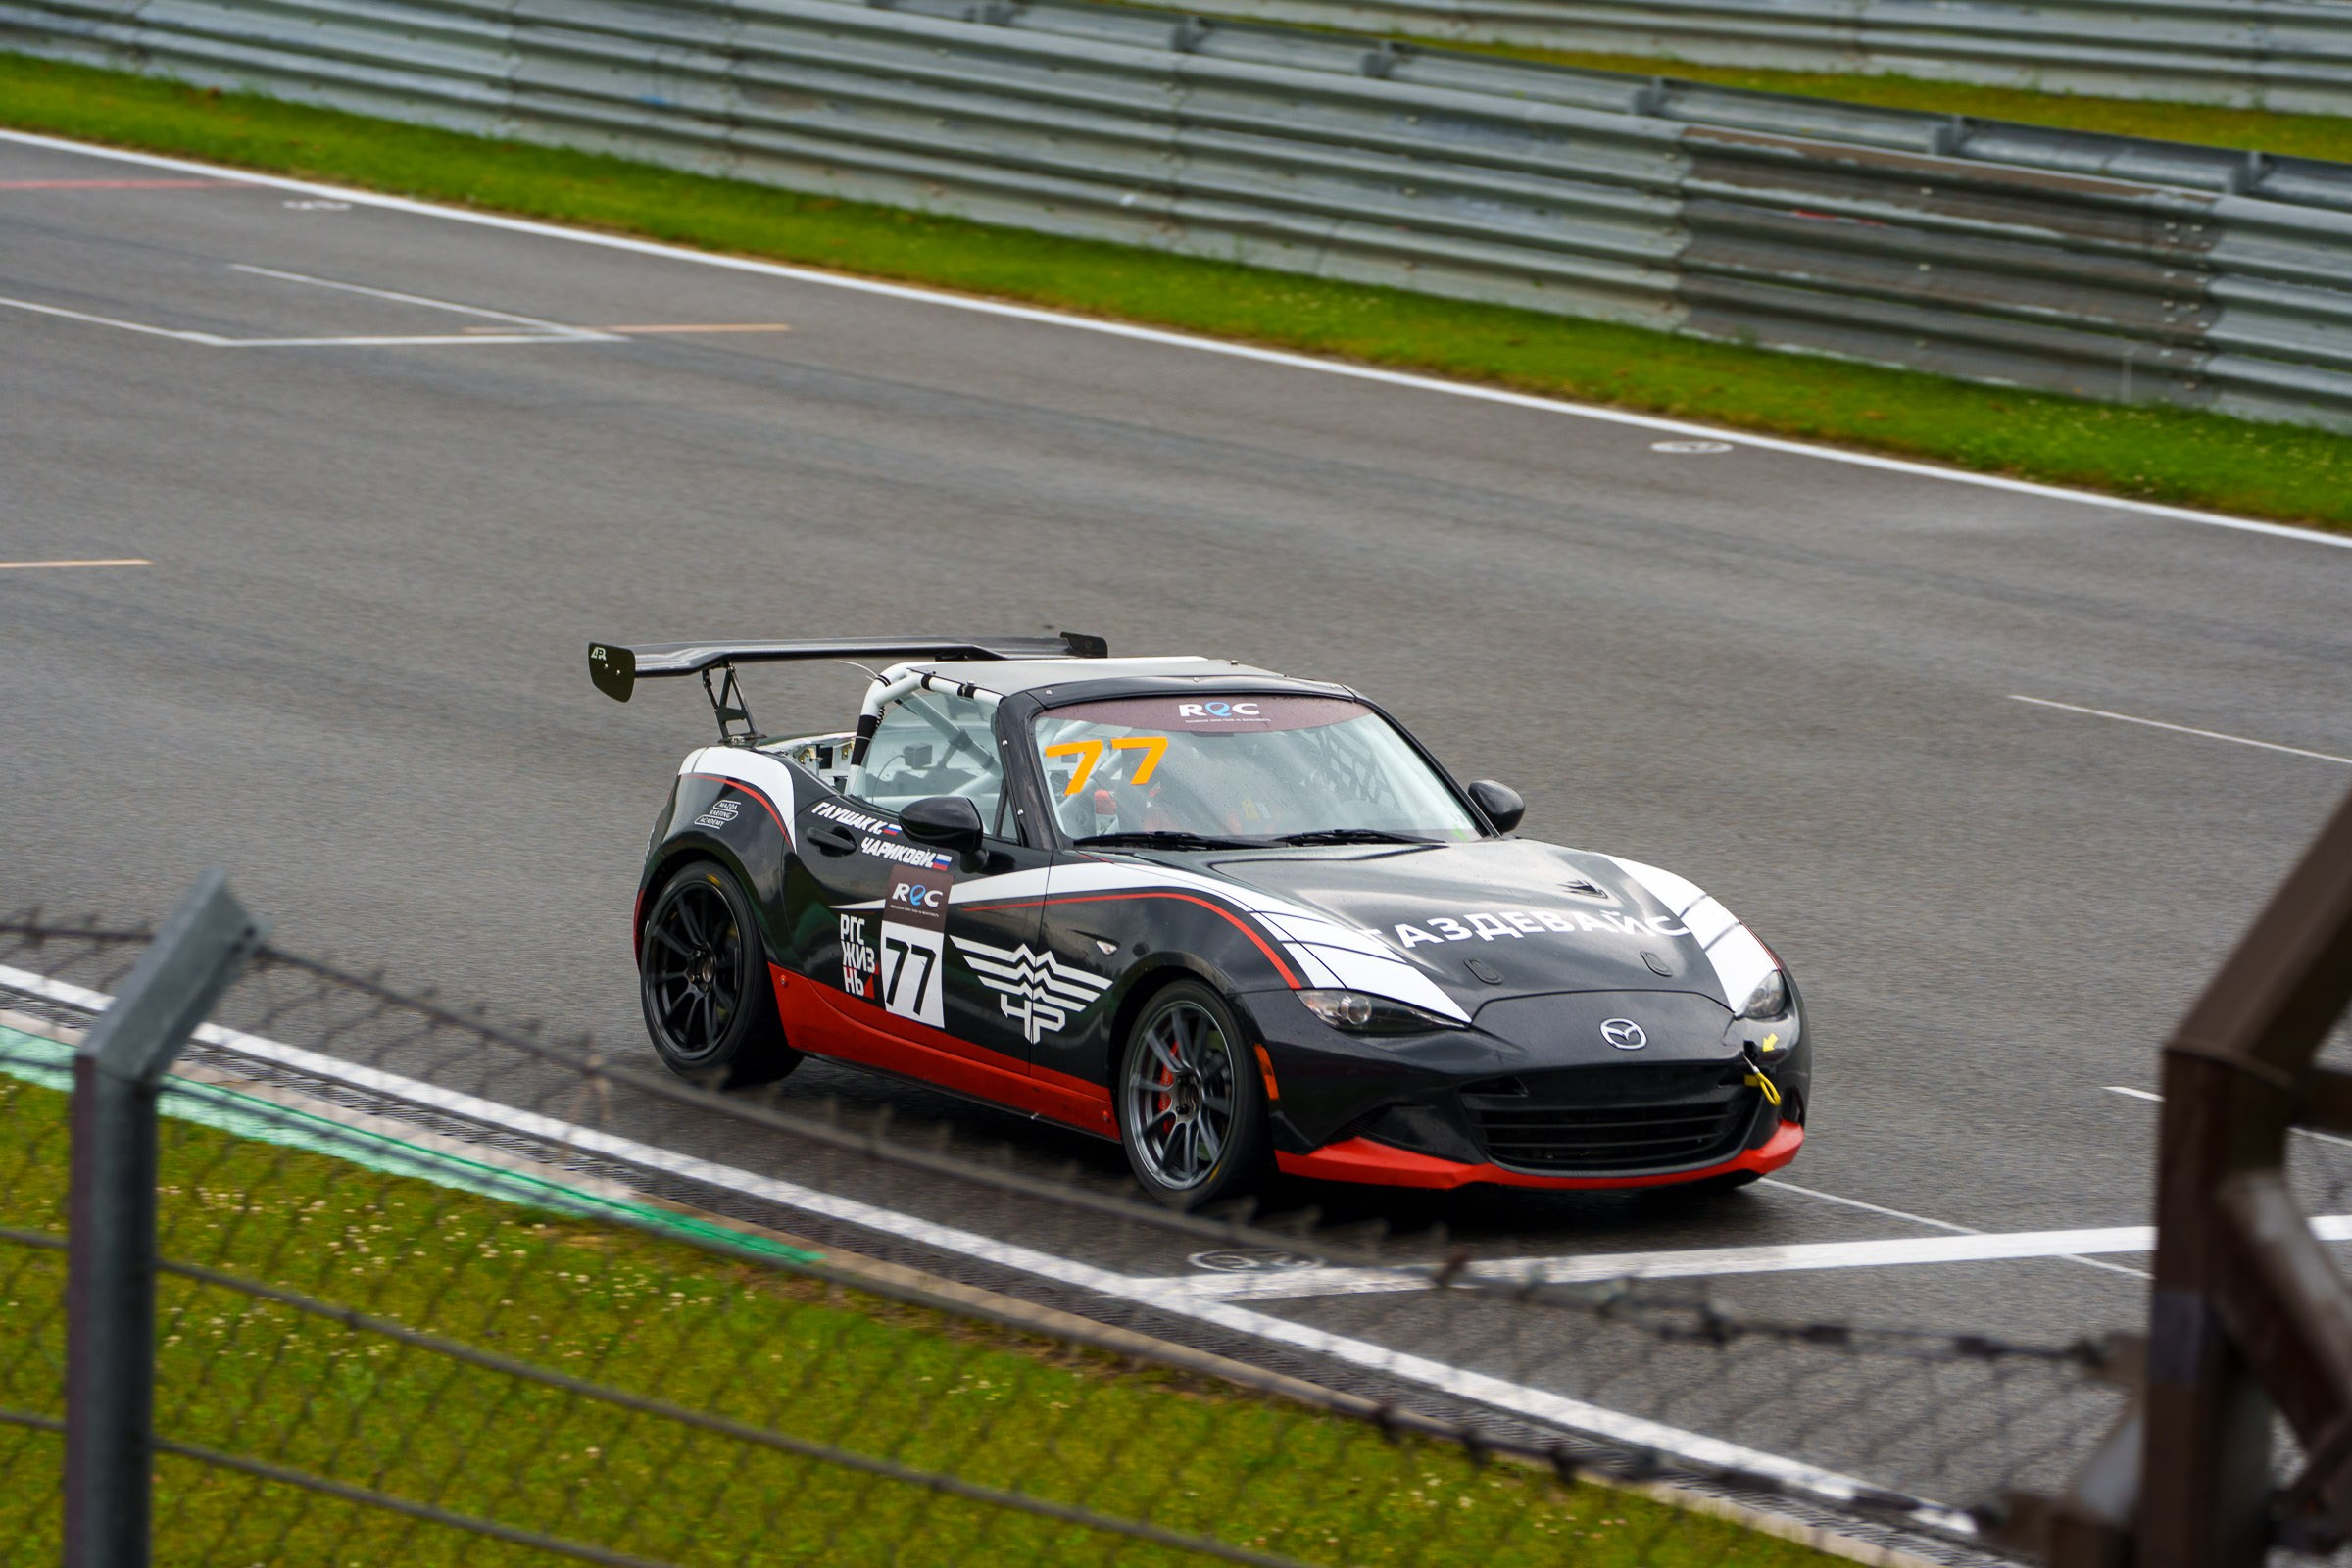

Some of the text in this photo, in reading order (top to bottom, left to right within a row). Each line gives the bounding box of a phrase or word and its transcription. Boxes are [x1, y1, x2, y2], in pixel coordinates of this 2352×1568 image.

[1045, 736, 1168, 797] 77
[811, 801, 877, 831] ГЛУШАК
[840, 913, 865, 945] РГС
[841, 940, 876, 974] ЖИЗ
[886, 936, 937, 1017] 77
